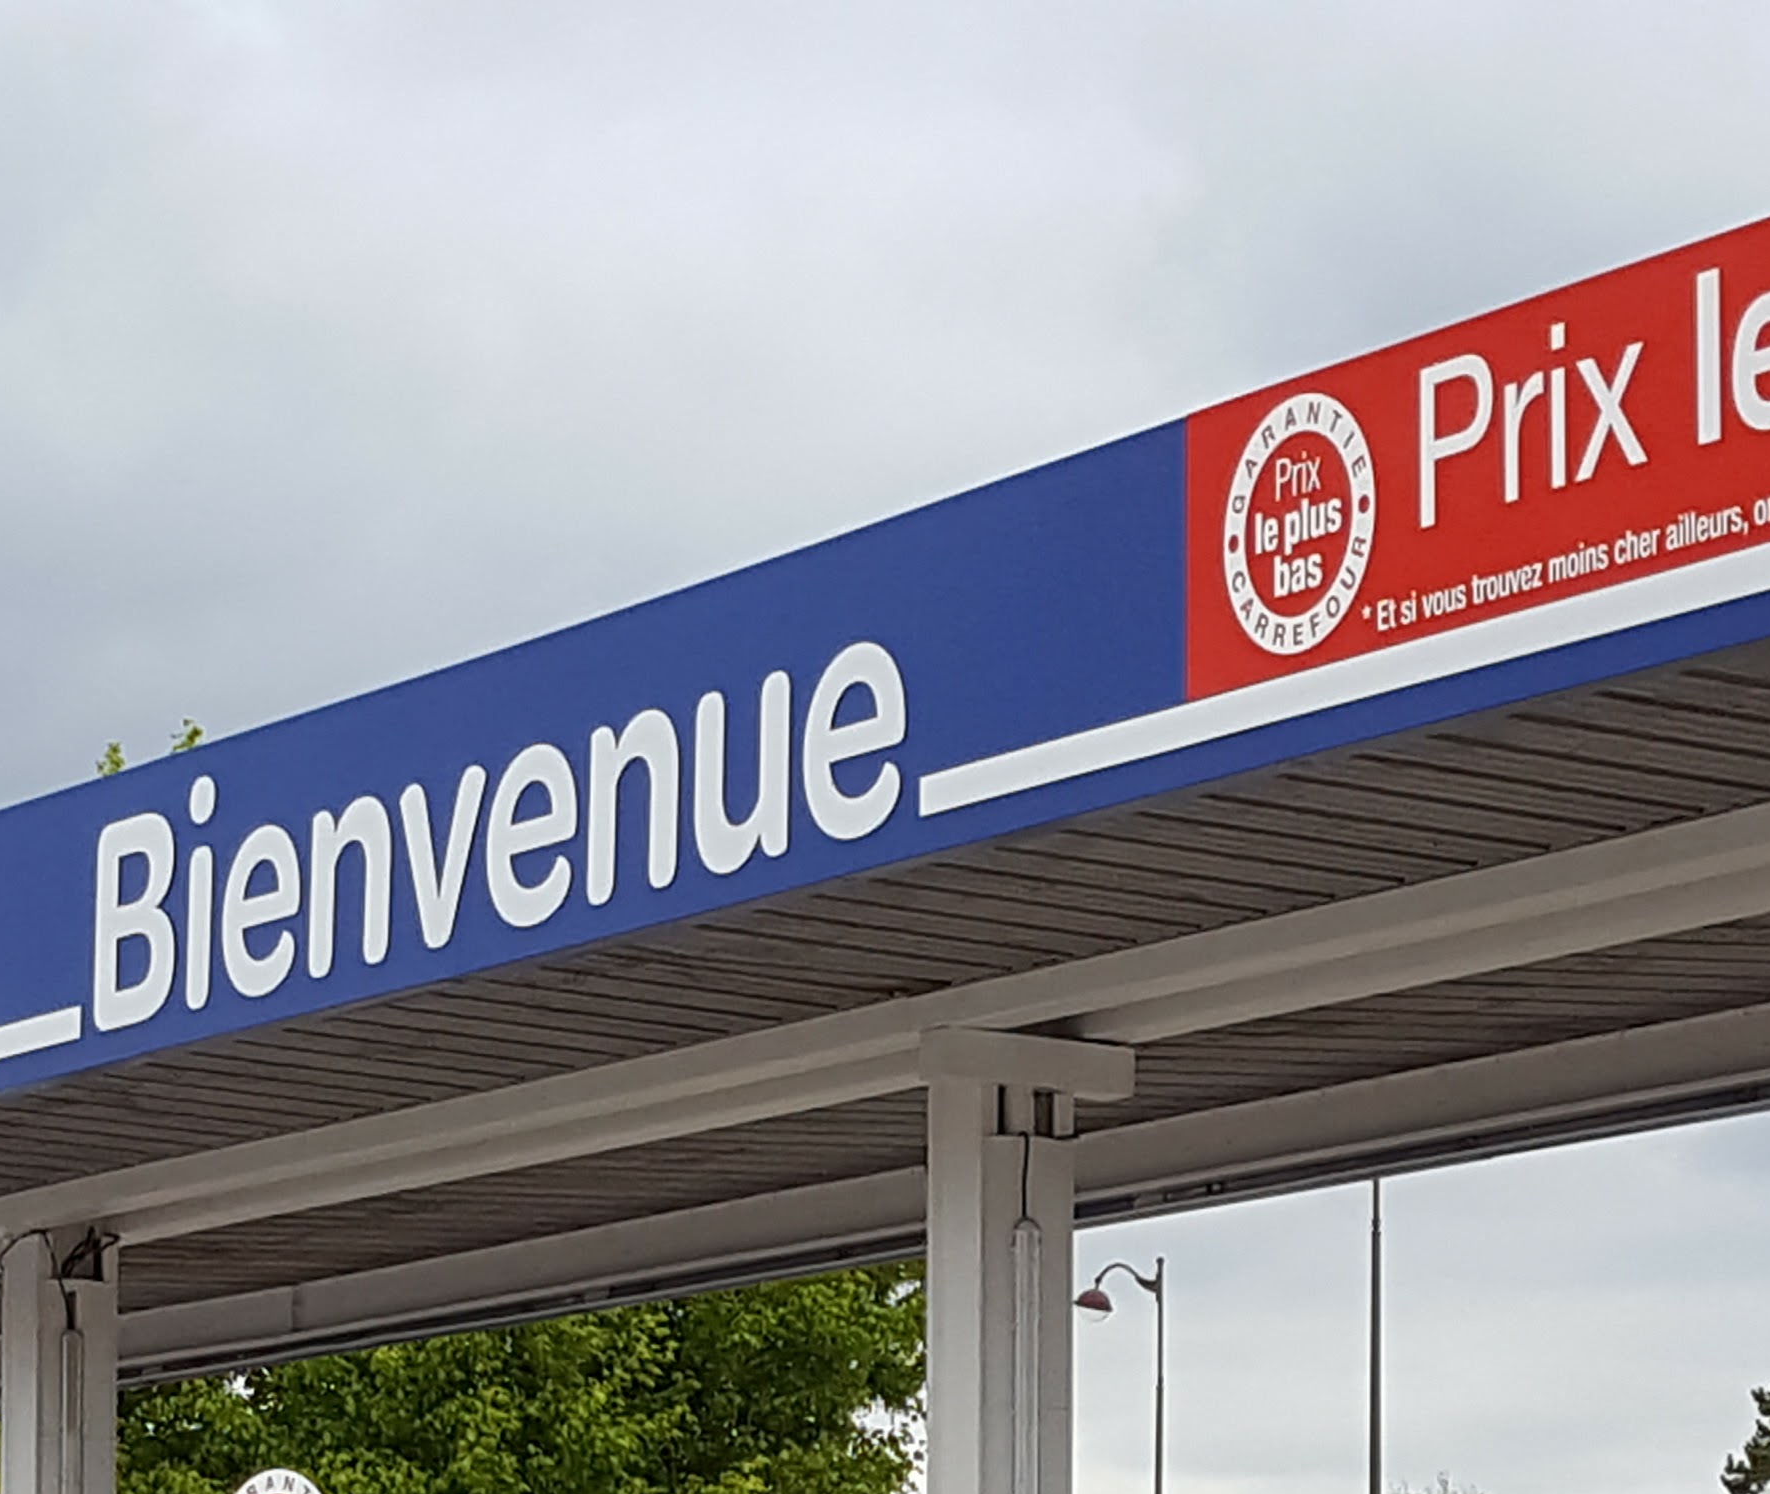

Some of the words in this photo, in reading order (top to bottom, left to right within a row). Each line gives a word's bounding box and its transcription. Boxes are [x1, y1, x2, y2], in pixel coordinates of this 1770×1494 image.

[1232, 402, 1366, 514] GARANTIE
[1275, 450, 1321, 502] Prix
[1419, 322, 1648, 528] Prix
[1255, 512, 1278, 555] le
[1284, 498, 1342, 556] plus
[1274, 553, 1323, 598] bas
[1401, 595, 1417, 625] si
[1422, 582, 1467, 617] vous
[1471, 562, 1543, 604] trouvez
[1548, 541, 1609, 583] moins
[1614, 526, 1660, 565] cher
[1665, 506, 1749, 551] ailleurs,
[1232, 537, 1366, 647] CARREFOUR
[93, 641, 906, 1032] Bienvenue
